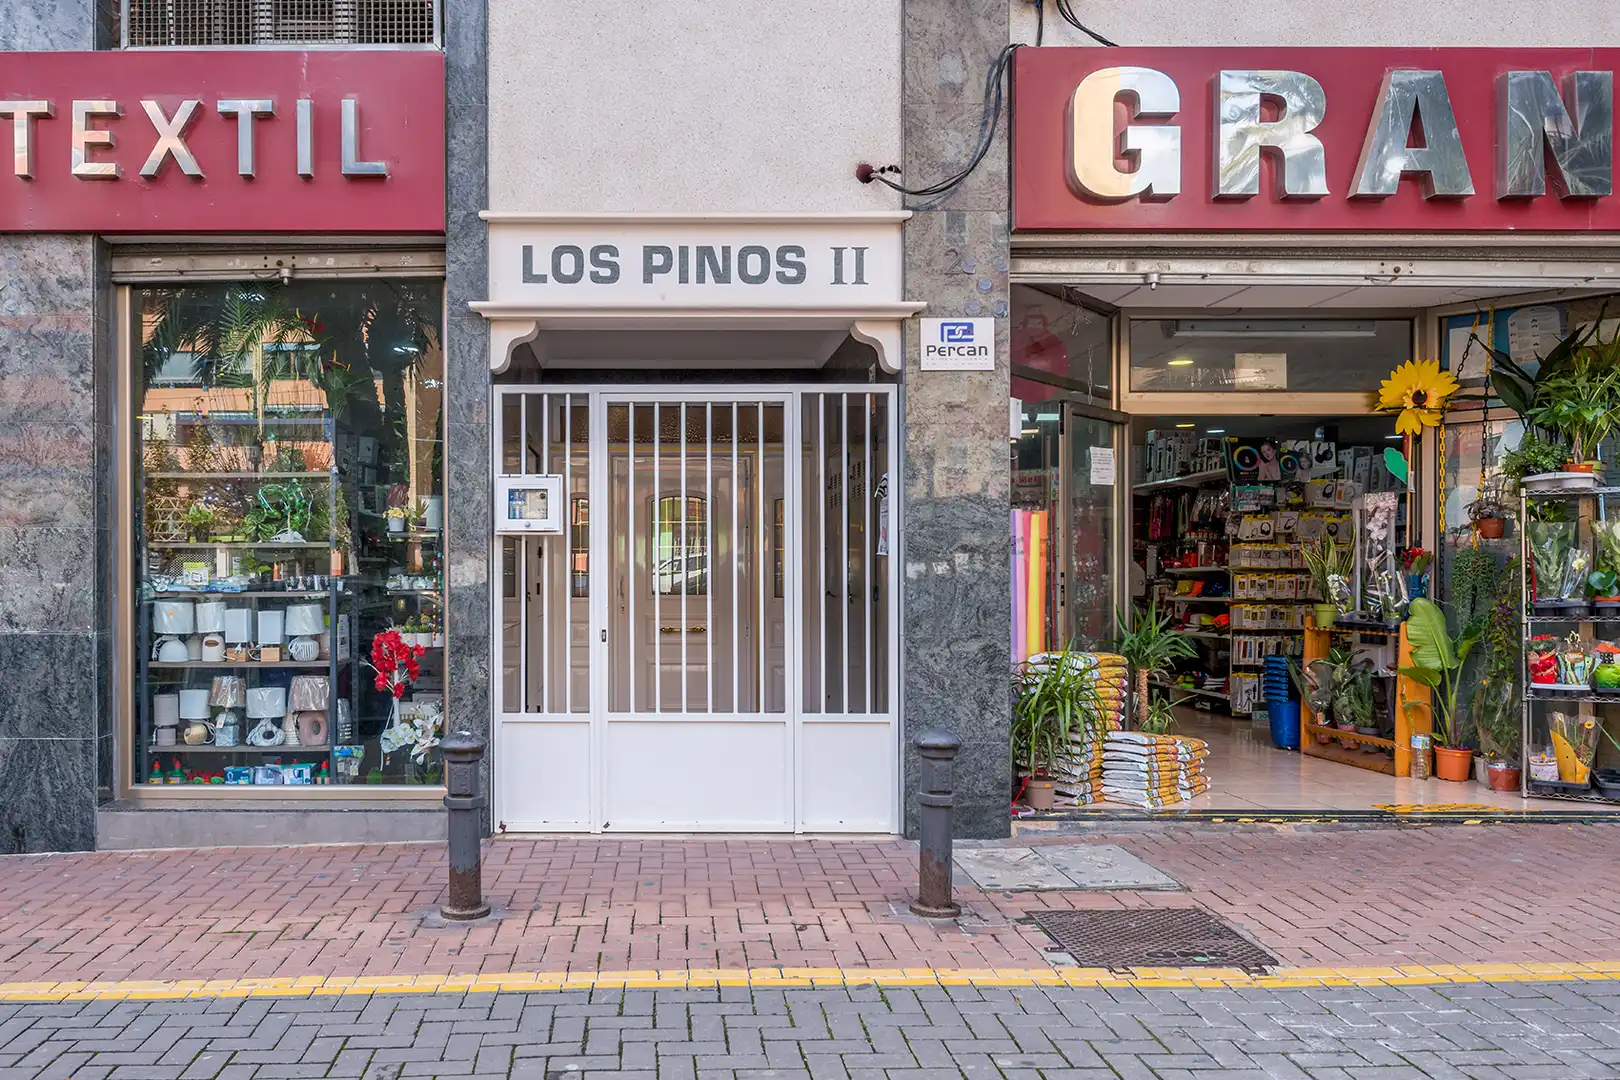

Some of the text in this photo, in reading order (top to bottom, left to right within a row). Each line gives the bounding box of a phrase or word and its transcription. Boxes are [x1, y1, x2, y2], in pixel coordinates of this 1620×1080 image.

[0, 98, 390, 181] TEXTIL
[1066, 66, 1614, 202] GRAN
[522, 244, 869, 285] LOS PINOS II
[926, 345, 988, 357] Percan
